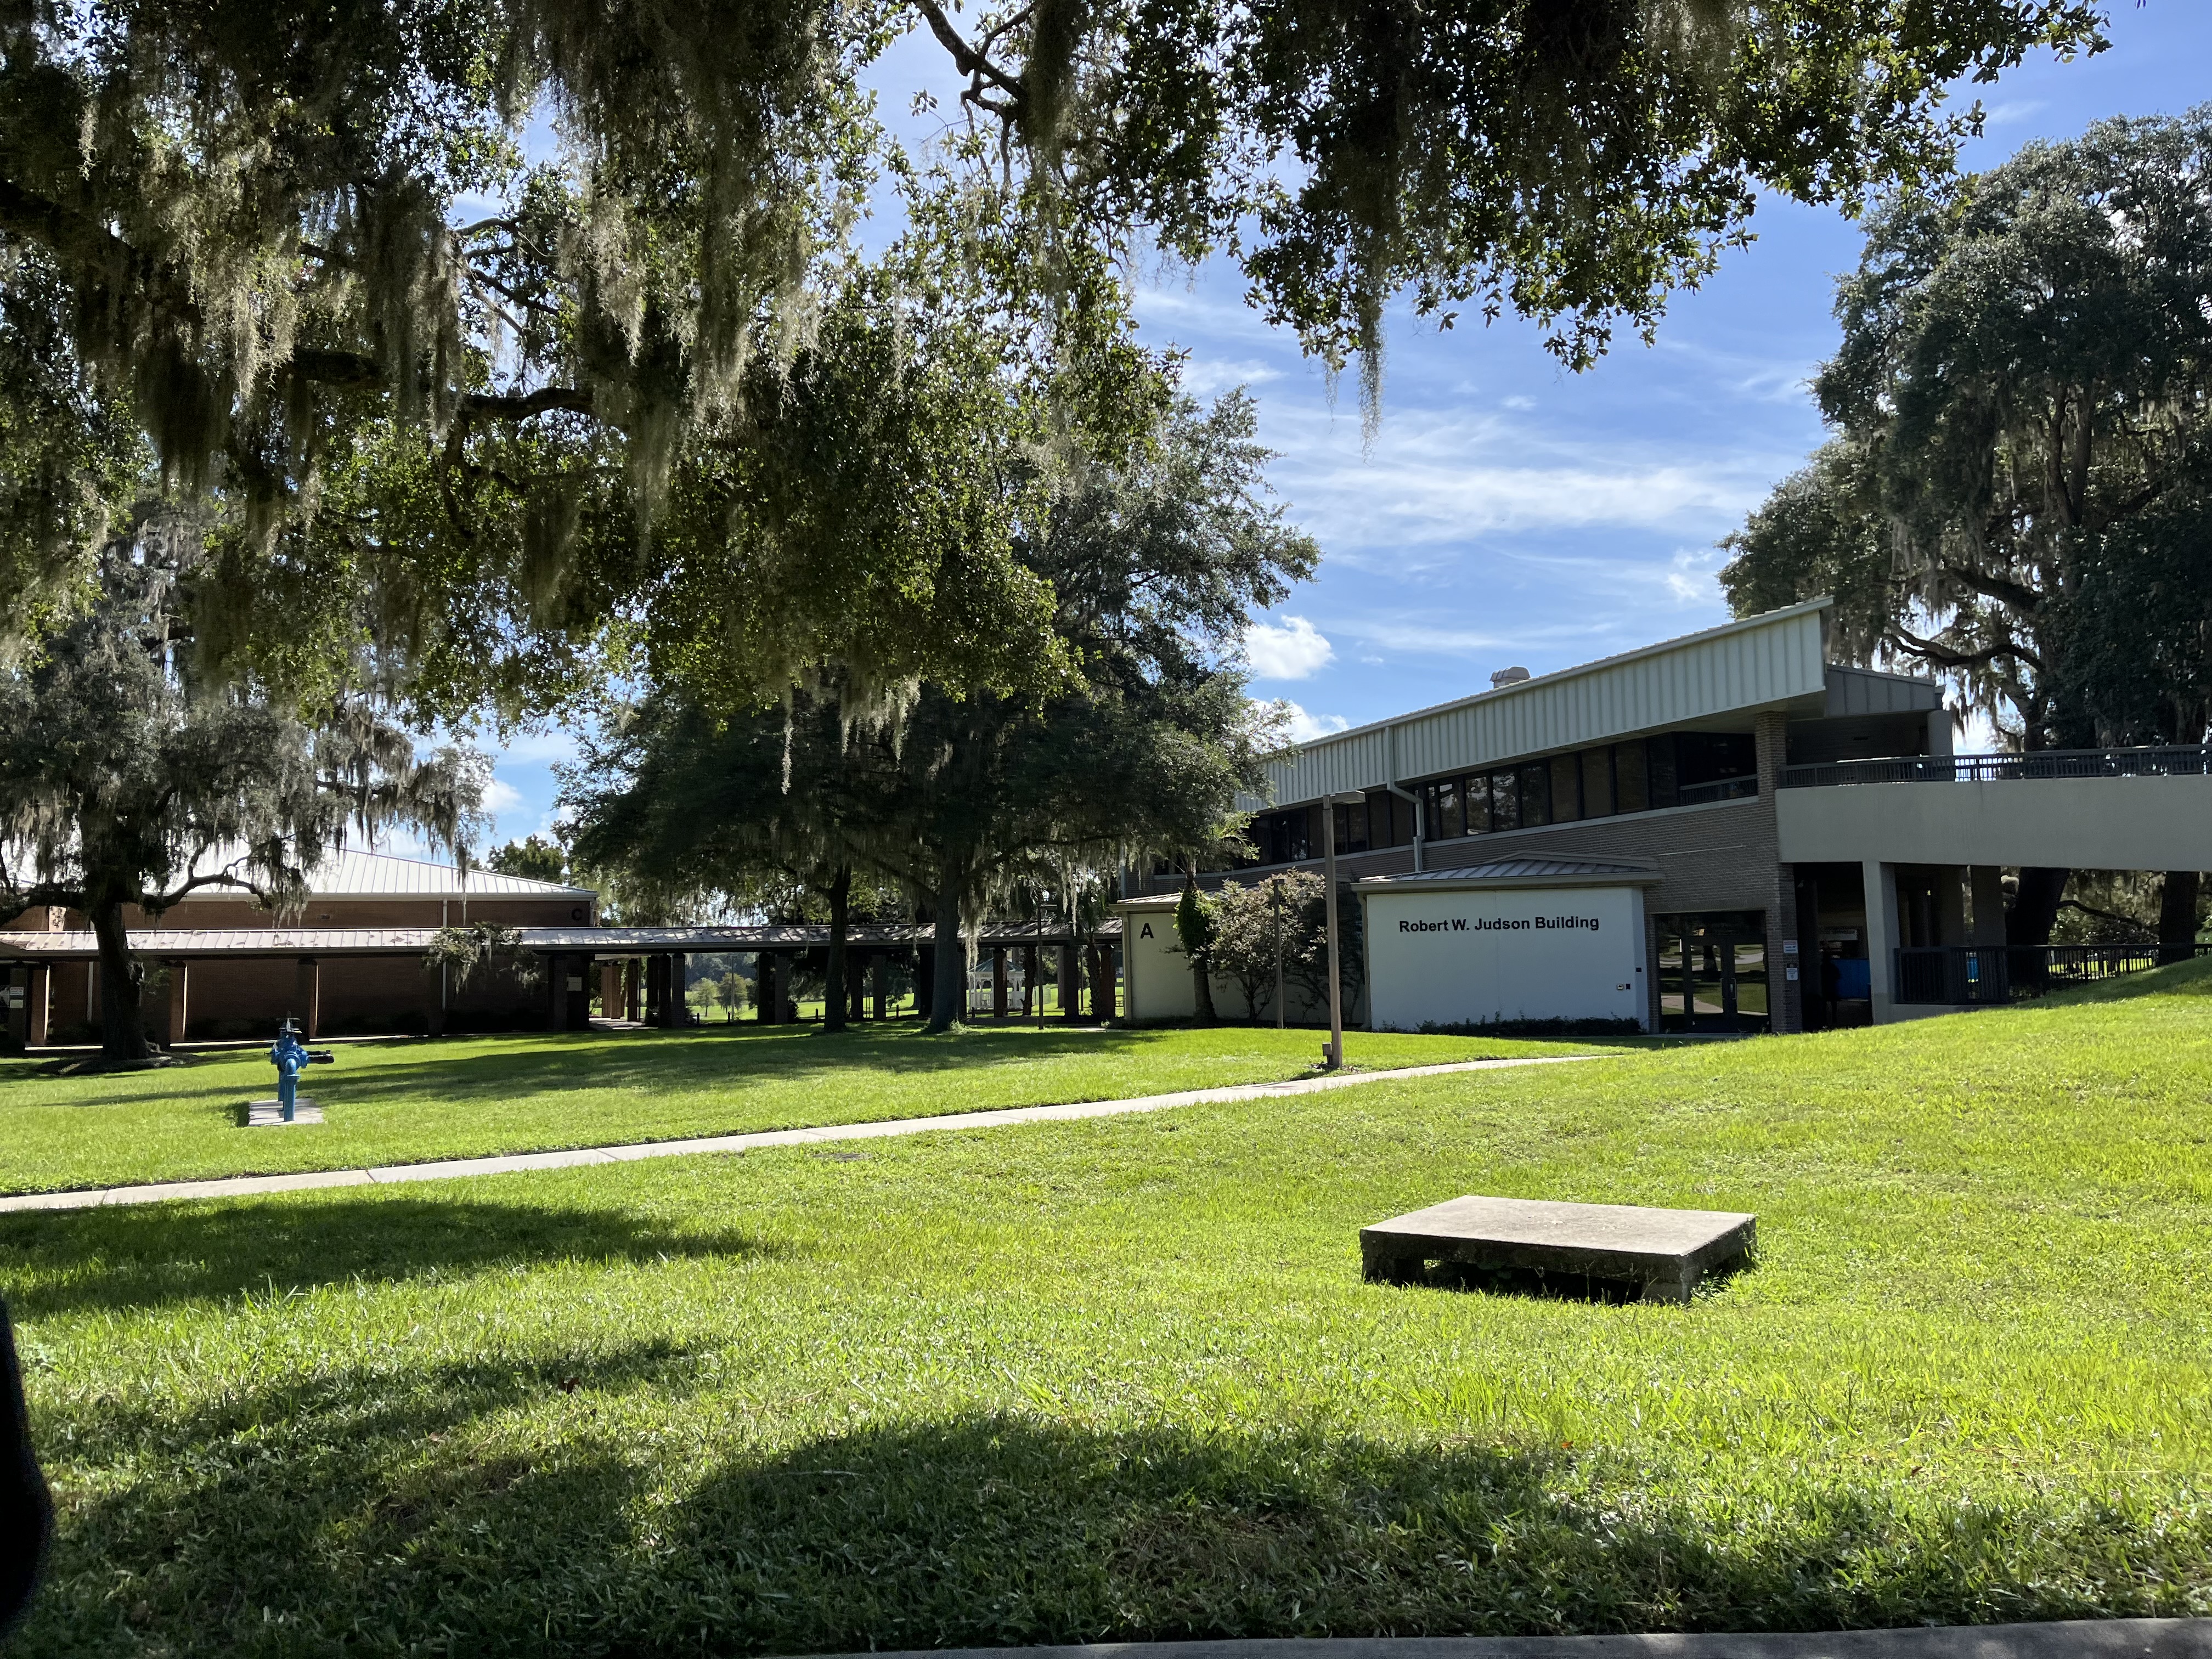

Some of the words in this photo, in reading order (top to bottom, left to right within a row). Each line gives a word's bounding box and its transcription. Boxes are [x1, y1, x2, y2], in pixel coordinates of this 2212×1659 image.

[571, 908, 583, 921] C
[1140, 923, 1154, 939] A
[1400, 919, 1449, 932] Robert
[1452, 918, 1470, 931] W.
[1474, 918, 1530, 930] Judson
[1535, 916, 1600, 931] Building
